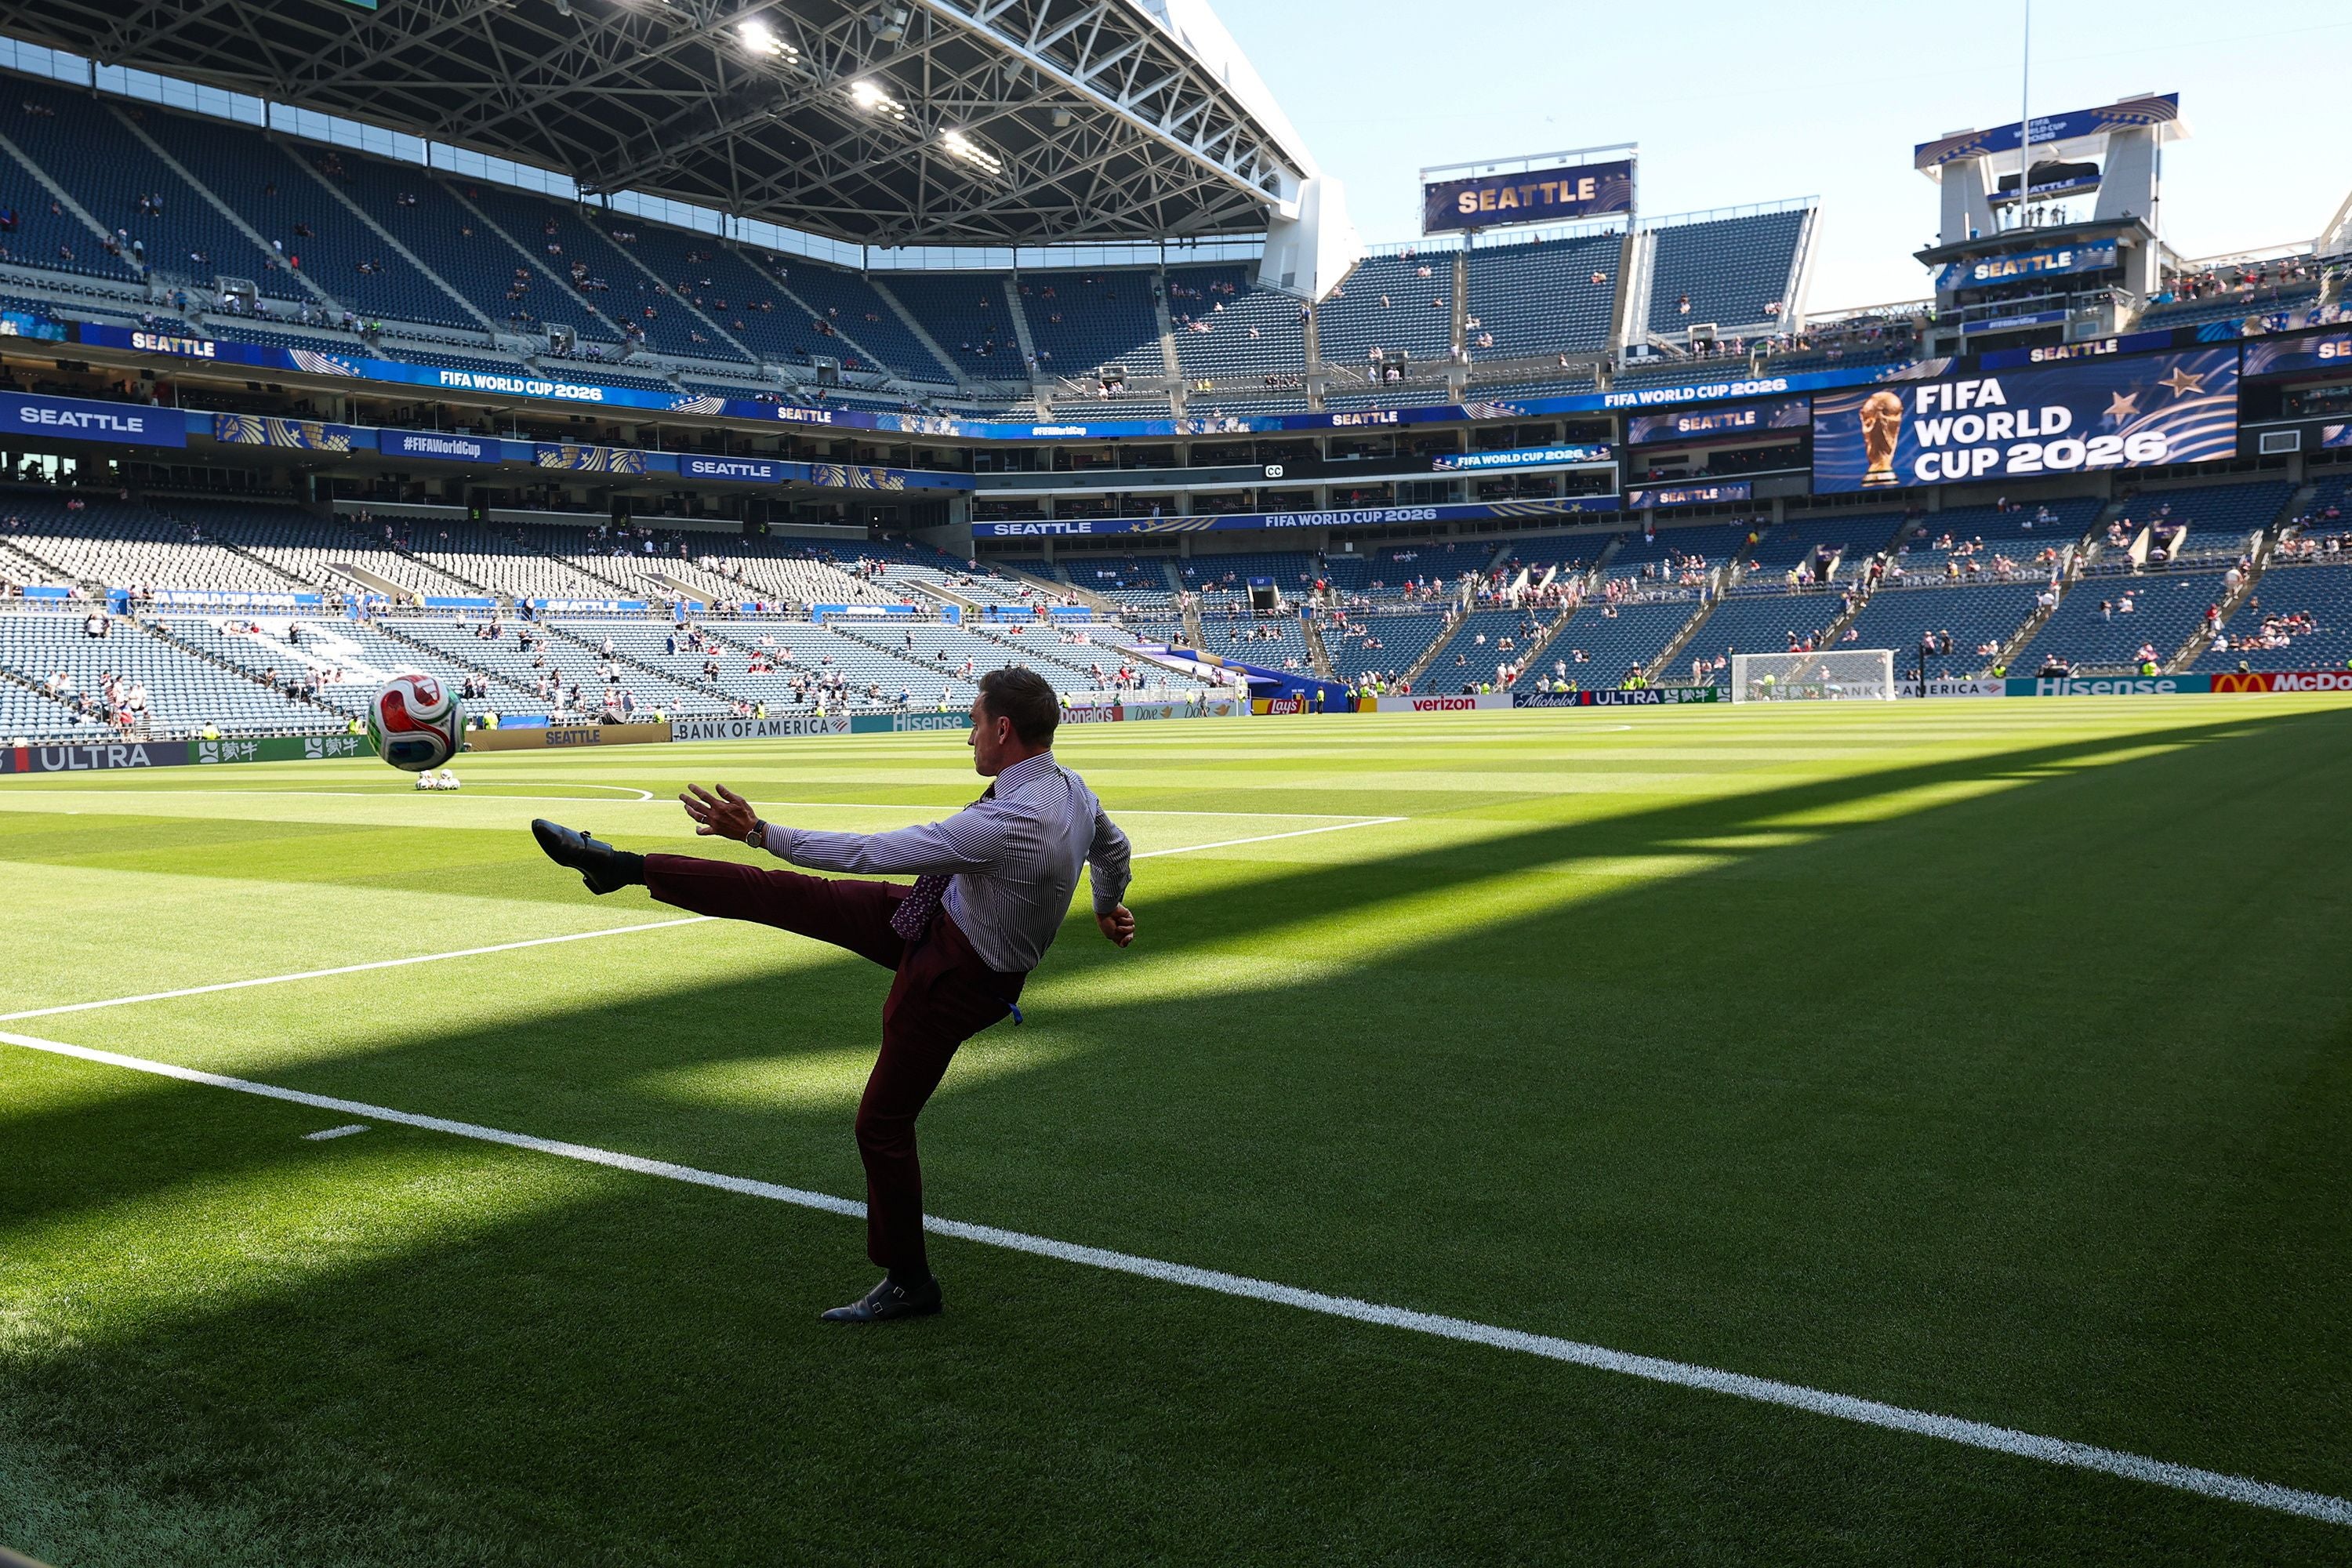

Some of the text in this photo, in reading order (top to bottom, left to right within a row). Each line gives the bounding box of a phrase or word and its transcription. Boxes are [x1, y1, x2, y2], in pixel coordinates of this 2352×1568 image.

[1458, 177, 1595, 214] SEATTLE
[2010, 179, 2075, 197] SATTLE
[1974, 251, 2071, 280] SEATTLE
[132, 332, 215, 358] SEATTLE
[2031, 339, 2118, 362] SEATTLE
[2318, 340, 2352, 359] SE
[440, 371, 603, 401] FIFA WORLD CUP 2026
[1605, 378, 1788, 407] FIFA WORLD CUP 2026
[1915, 377, 2007, 414] FIFA
[20, 407, 143, 433] SEATTLE
[778, 407, 832, 423] SEATTLE
[1332, 411, 1398, 426] SEATTLE
[1679, 411, 1755, 431] SEATTLE
[1914, 405, 2072, 448] WORLD
[403, 436, 481, 458] #FIFAWorldCup
[1914, 430, 2168, 481] CUP 2026
[1457, 448, 1584, 466] FIFA WORLD CUP 2026
[691, 461, 771, 477] SEATTLE
[1267, 466, 1281, 476] CC
[1660, 488, 1718, 503] SEATTLE
[1265, 508, 1437, 527] FIFA WORLD CUP 2026
[994, 522, 1091, 535] SEATTLE
[171, 592, 221, 604] WORLD
[223, 593, 250, 606] CUP
[546, 600, 619, 612] SEATTLE
[1841, 684, 1872, 697] ANK
[2036, 677, 2177, 696] Hisense
[2271, 673, 2352, 691] McDo
[1271, 699, 1298, 714] Lay's
[1413, 695, 1475, 711] verizon
[1514, 691, 1660, 708] Michelob ULTRA
[1060, 707, 1113, 724] Donald's
[1135, 706, 1158, 720] Dove
[1185, 704, 1210, 719] Doe
[679, 718, 829, 739] BANK OF AMERICA
[893, 713, 964, 731] Hisense
[546, 729, 601, 745] SEATTLE
[222, 741, 258, 761] 蒙牛
[325, 737, 359, 757] 蒙牛
[41, 744, 151, 771] ULTRA
